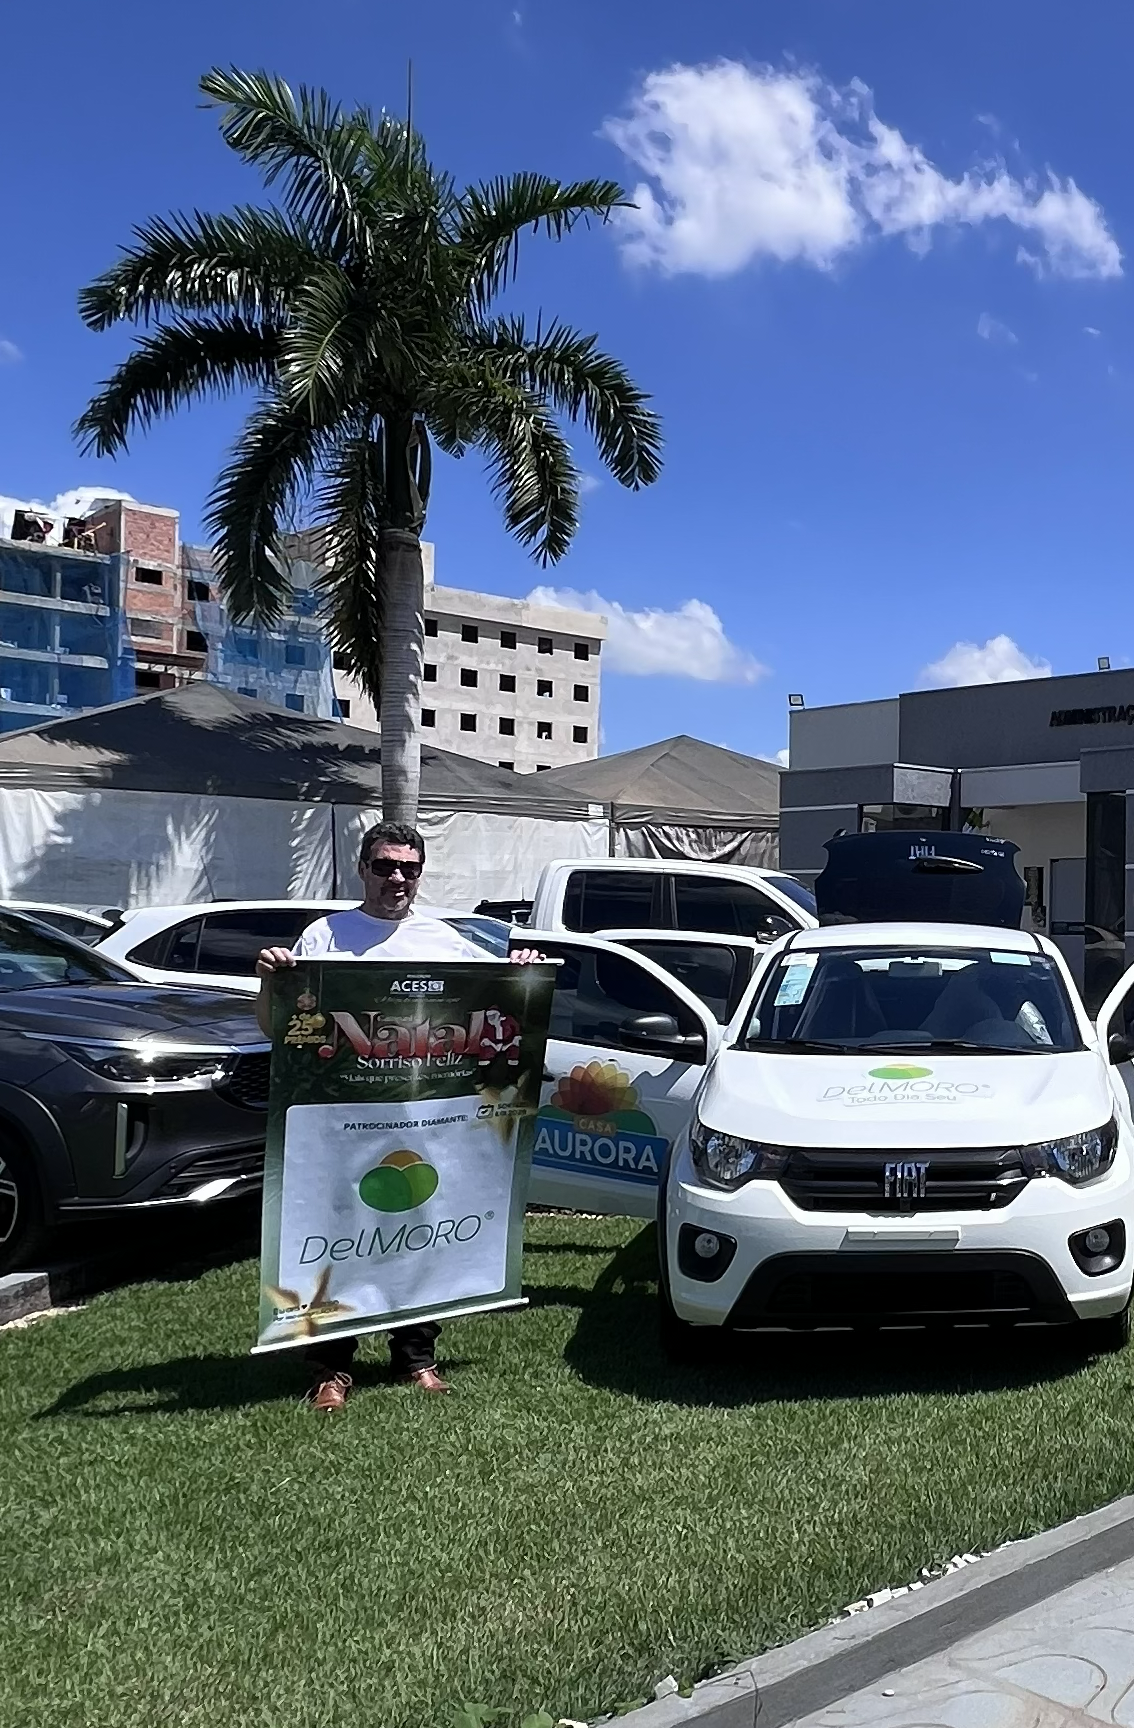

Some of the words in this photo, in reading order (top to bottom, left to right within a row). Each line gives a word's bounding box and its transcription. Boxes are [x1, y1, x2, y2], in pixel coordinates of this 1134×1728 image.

[390, 980, 427, 992] ACES
[288, 1019, 315, 1036] 25
[318, 1010, 486, 1058] Natal
[357, 1053, 422, 1070] Sorriso
[343, 1120, 419, 1131] PATROCINADOR
[579, 1118, 614, 1133] CASA
[534, 1128, 659, 1173] AURORA
[885, 1161, 930, 1197] FIAT
[299, 1214, 481, 1265] DelMORO
